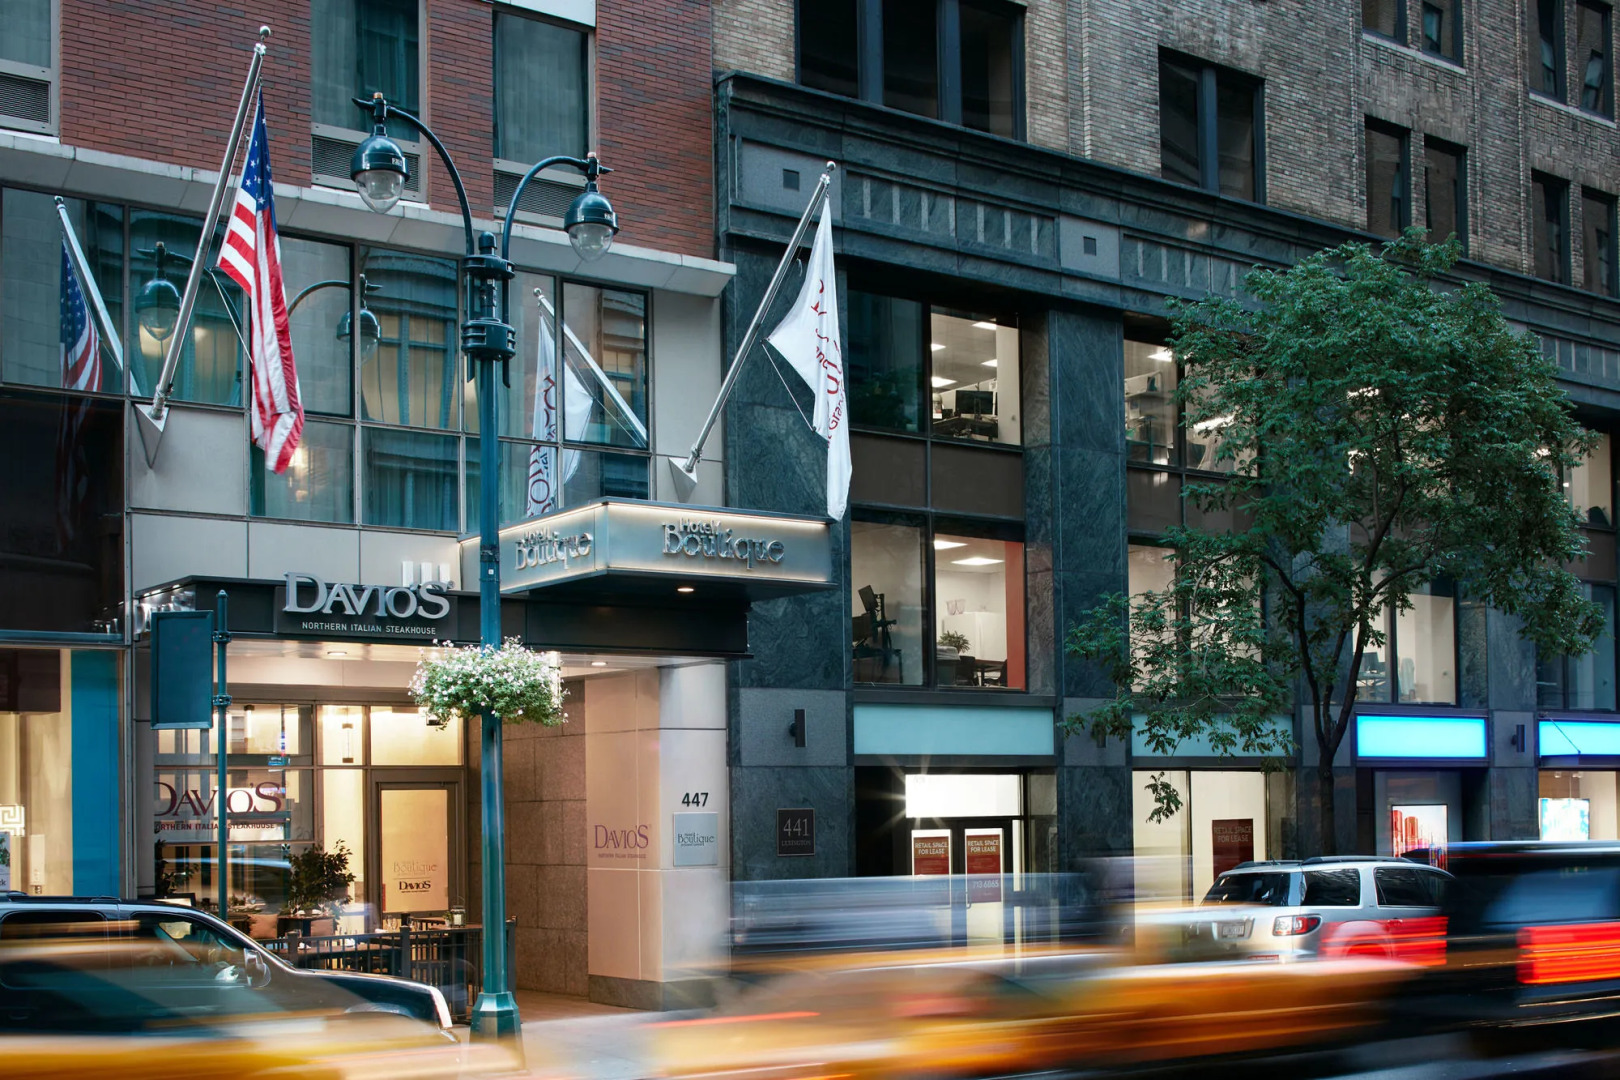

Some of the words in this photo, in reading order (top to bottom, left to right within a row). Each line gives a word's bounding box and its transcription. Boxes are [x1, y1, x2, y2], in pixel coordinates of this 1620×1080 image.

[680, 518, 716, 534] Hotel
[515, 531, 594, 570] Boutique
[662, 521, 785, 570] Boutique
[282, 572, 450, 619] DAVIO'S
[302, 621, 347, 631] NORTHERN
[351, 623, 382, 632] ITALIAN
[385, 625, 436, 635] STEAKHOUSE
[154, 782, 282, 817] DAVO'S
[681, 792, 709, 807] 447
[594, 824, 649, 849] DAVIO'S
[783, 818, 809, 837] 441
[677, 832, 715, 846] Boutique
[393, 860, 438, 875] Boutique
